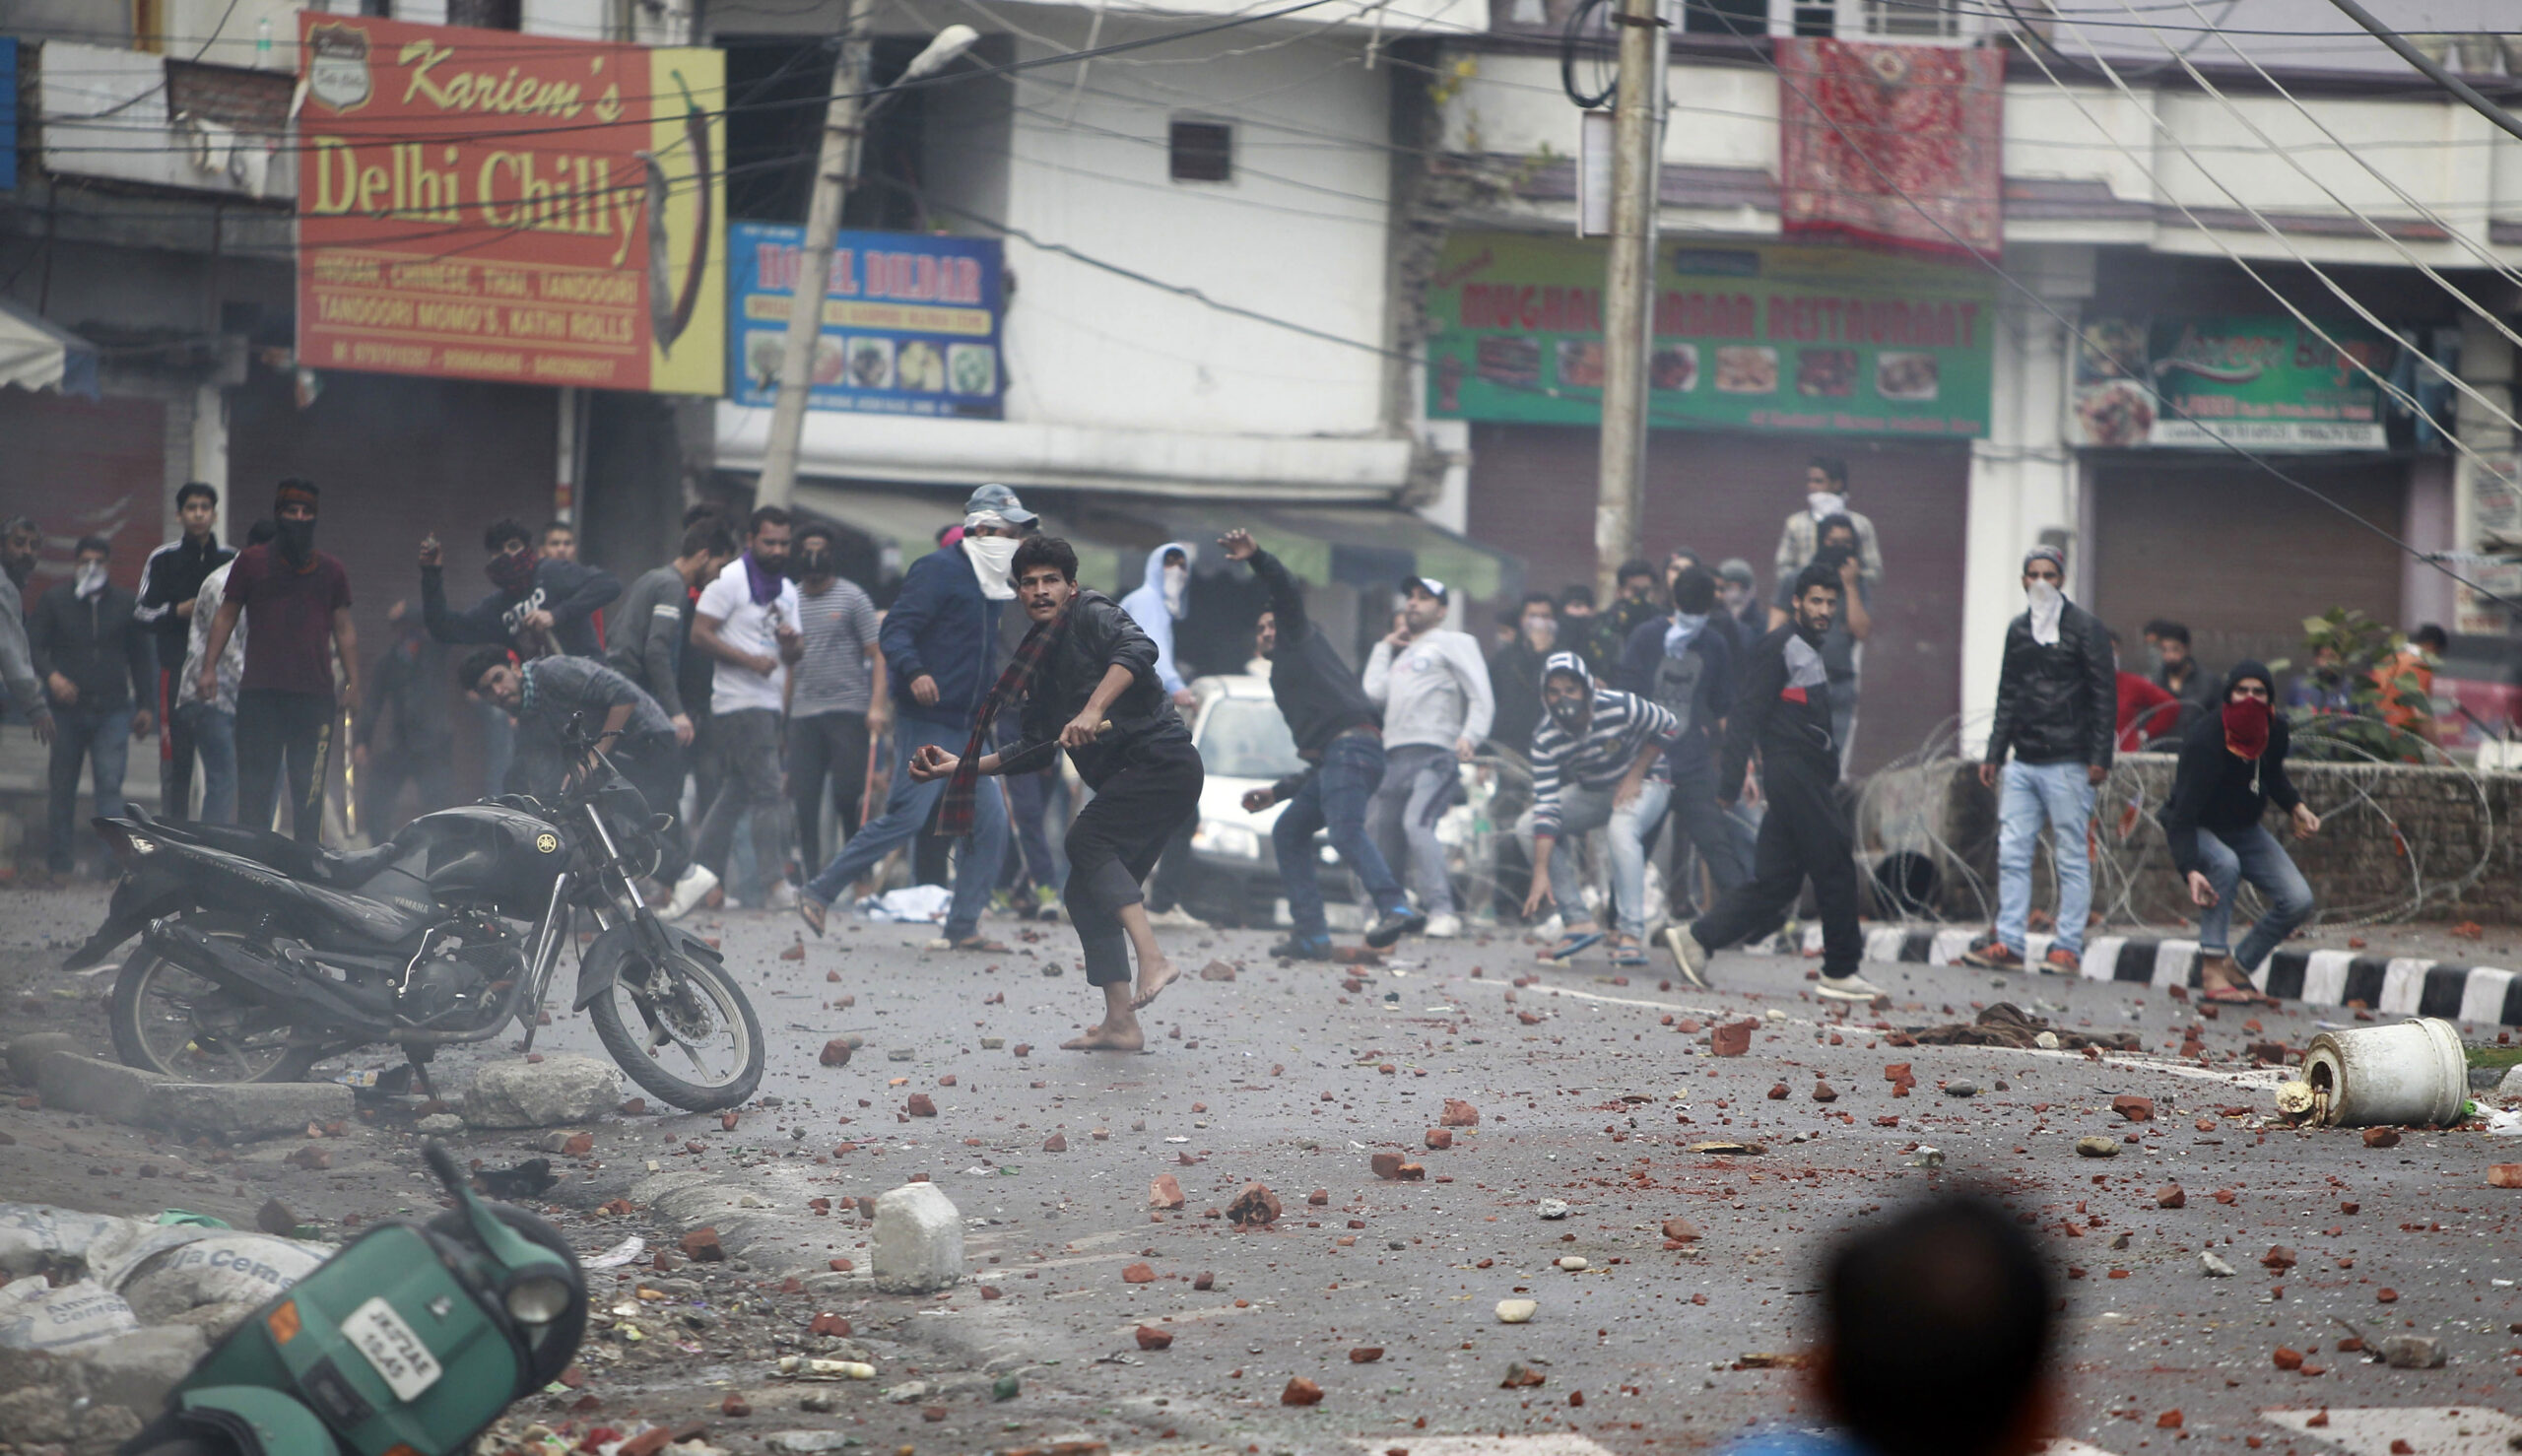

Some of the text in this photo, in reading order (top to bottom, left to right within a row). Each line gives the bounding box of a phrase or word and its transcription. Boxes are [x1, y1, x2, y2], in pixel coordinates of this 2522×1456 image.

[397, 38, 625, 123] Kariem's
[312, 136, 646, 268] Delhi Chilly
[316, 294, 414, 328] TANDOORI
[569, 312, 635, 344] ROLLS
[1460, 283, 1602, 330] MUGHAL
[394, 895, 429, 914] YAMAHA
